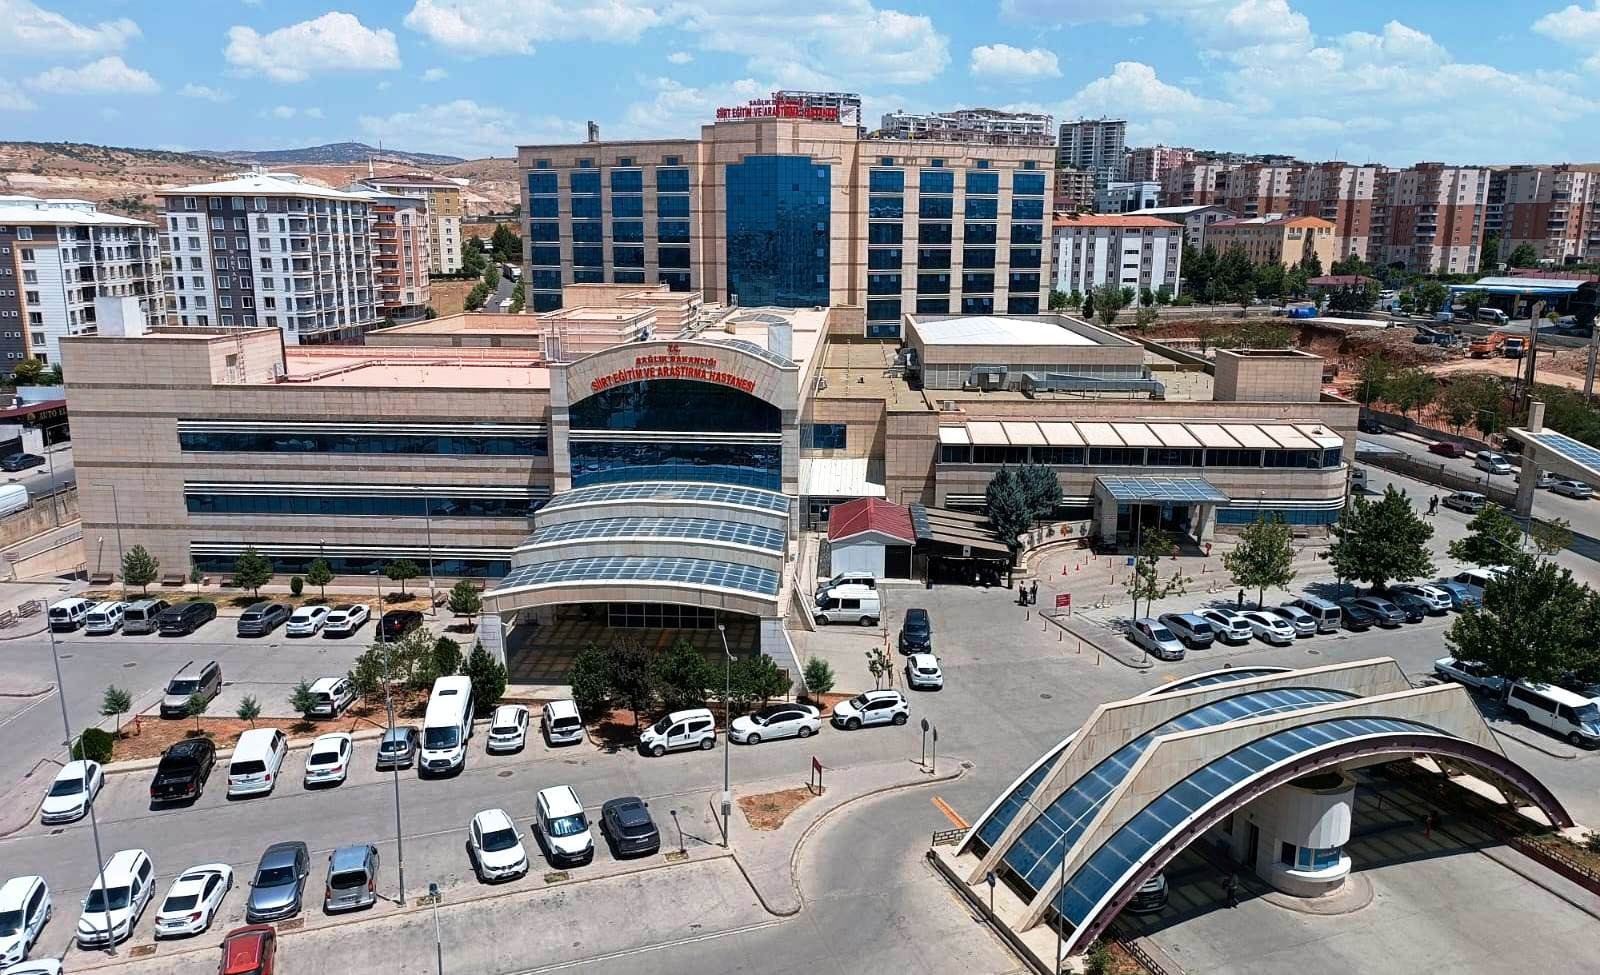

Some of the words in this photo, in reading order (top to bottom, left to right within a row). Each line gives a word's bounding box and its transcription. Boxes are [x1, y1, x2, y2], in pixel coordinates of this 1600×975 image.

[749, 98, 770, 106] SAĞLIK
[732, 105, 752, 118] EĞİTİM
[754, 106, 763, 117] VE
[668, 344, 681, 353] T.C.
[636, 355, 667, 365] SAĞLIK
[671, 355, 717, 368] BAKANLIĞI
[591, 374, 614, 391] SİİRT
[613, 367, 643, 384] EĞİTİM
[644, 367, 656, 379] VE
[657, 366, 706, 380] ARAŞTIRMA
[709, 370, 757, 393] HASTANESİ
